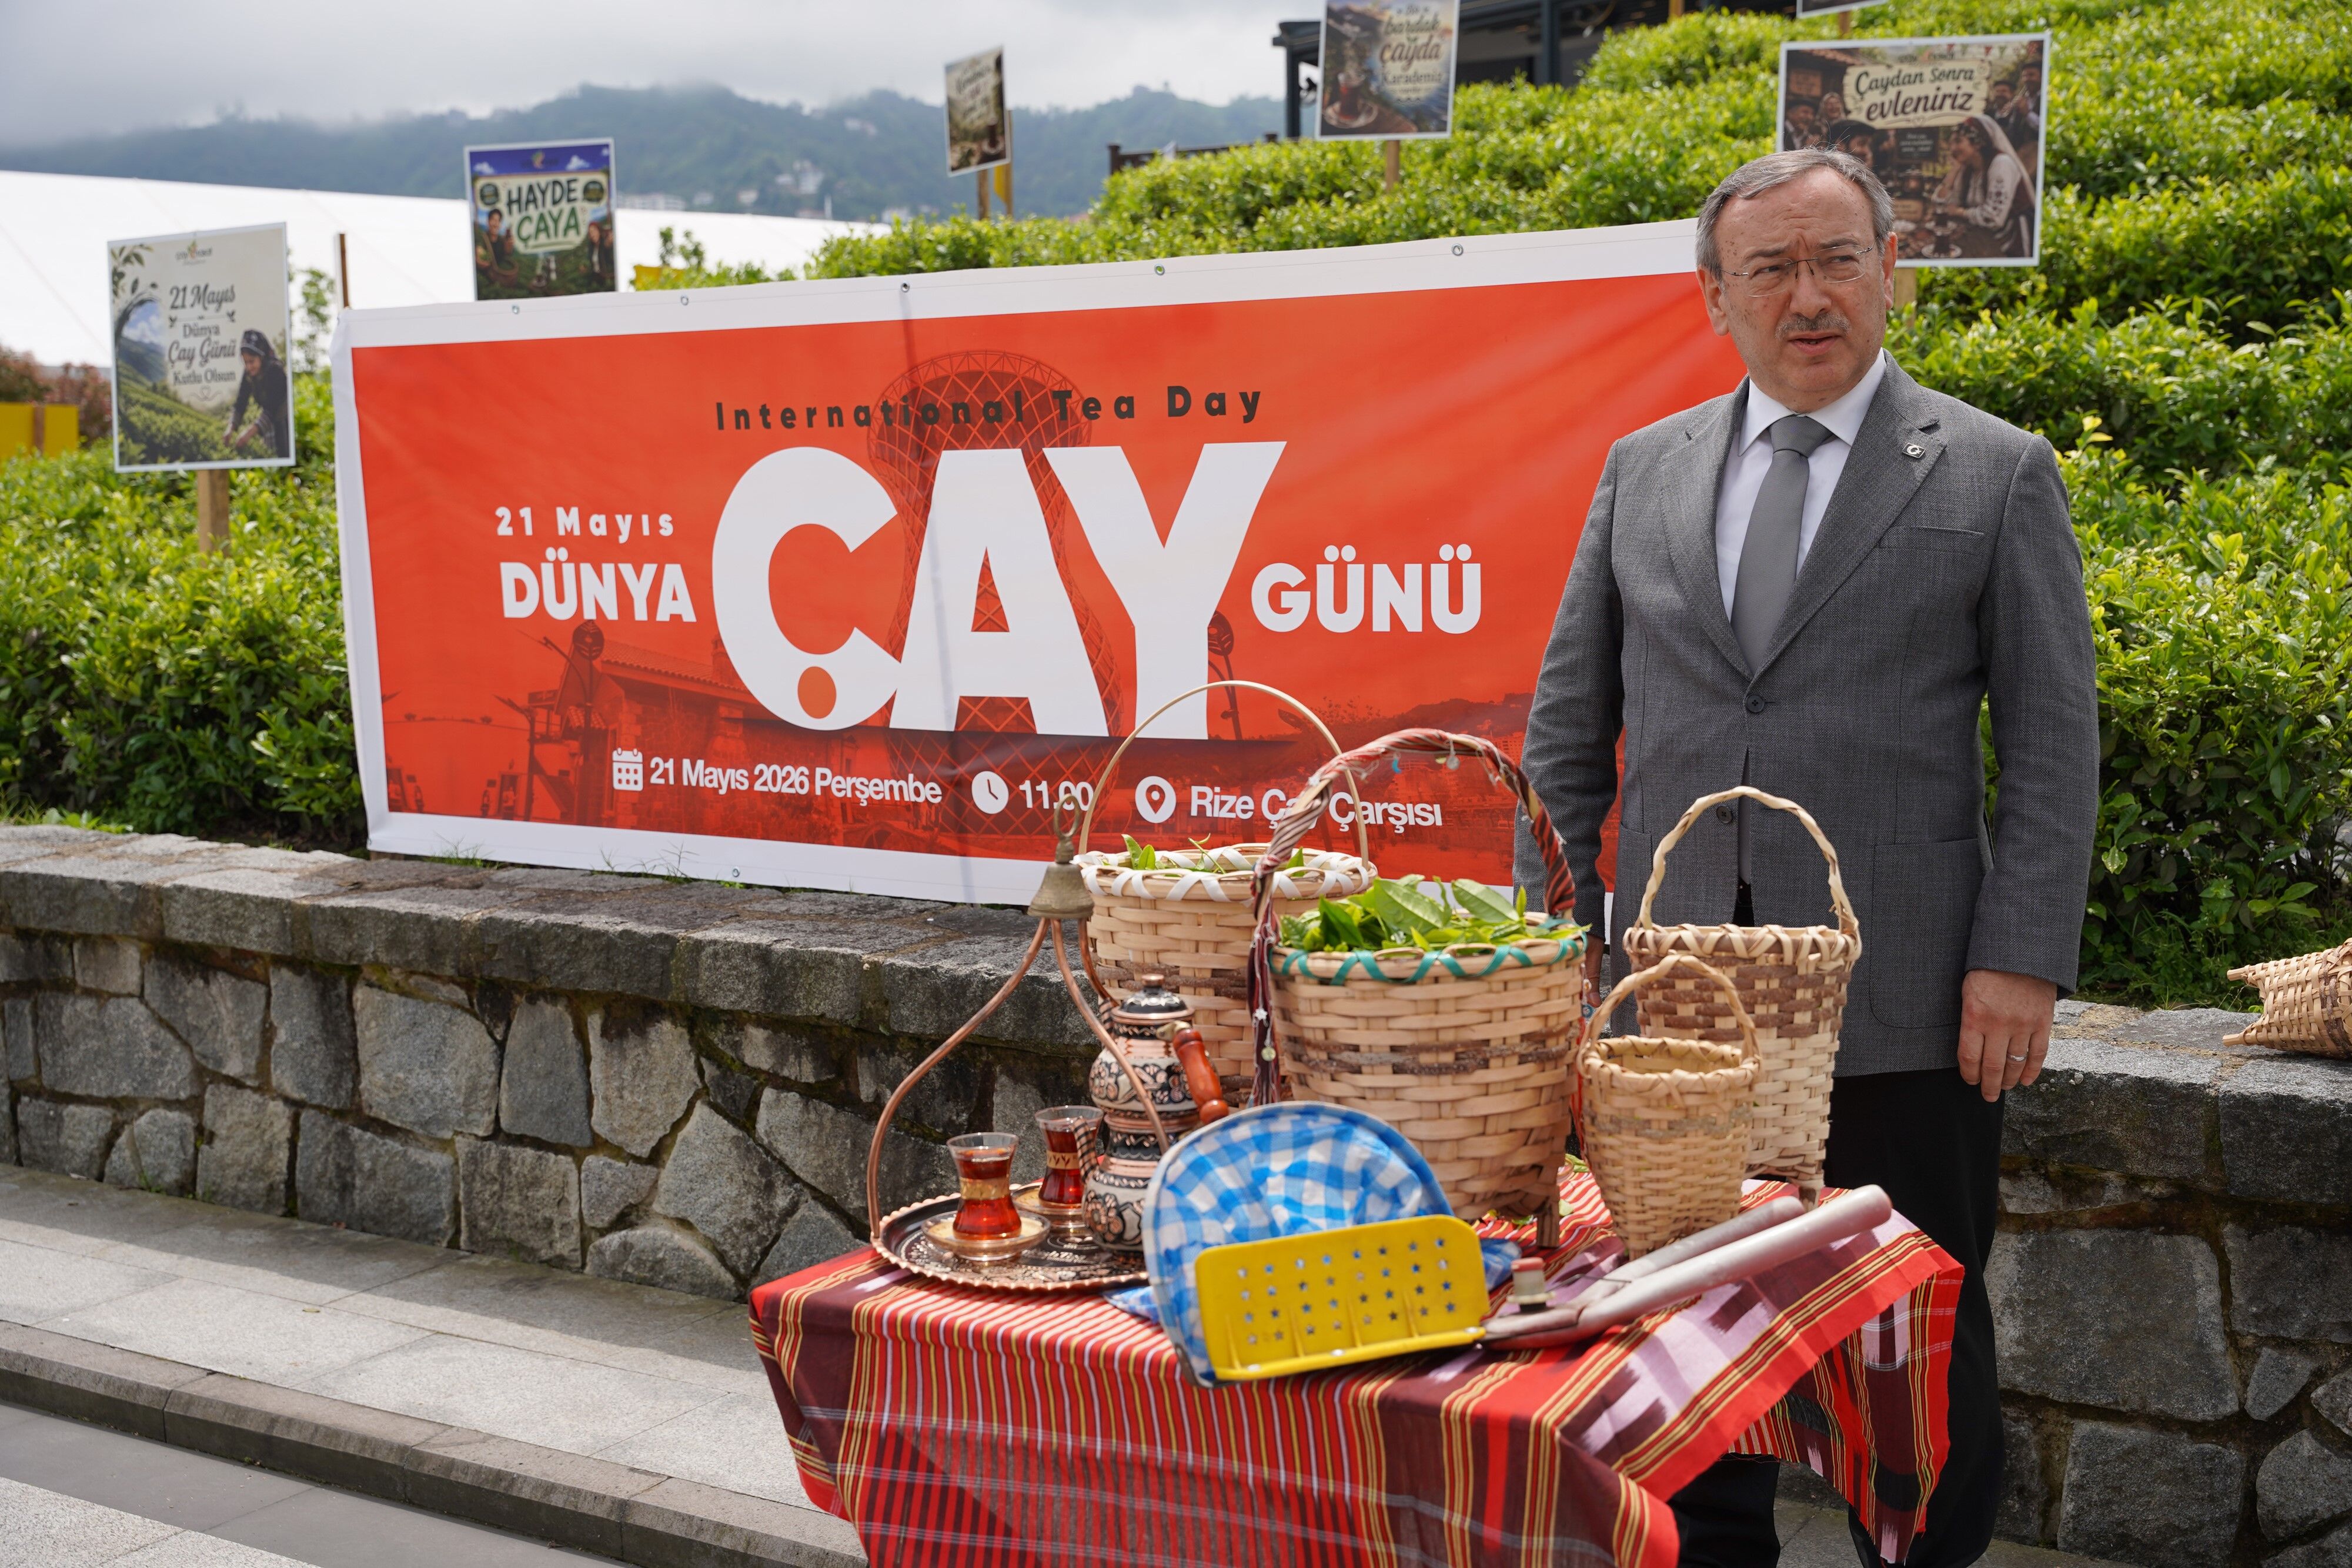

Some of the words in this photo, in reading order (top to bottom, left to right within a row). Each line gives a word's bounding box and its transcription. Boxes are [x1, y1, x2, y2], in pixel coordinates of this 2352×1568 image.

[1856, 68, 1923, 101] Çaydan
[1930, 66, 1974, 82] Sonra
[1866, 85, 1973, 121] evleniriz
[506, 178, 579, 215] HAYDE
[517, 206, 580, 248] ÇAYA
[170, 285, 187, 310] 21
[190, 283, 236, 312] Mayıs
[183, 323, 220, 342] Dünya
[168, 340, 195, 369] Çay
[199, 338, 236, 367] Günü
[173, 370, 202, 385] Kutlu
[204, 368, 236, 384] Olsun
[716, 391, 1023, 430] International
[1053, 390, 1134, 420] Tea
[1167, 386, 1261, 423] Day
[495, 506, 533, 536] 21
[556, 506, 674, 544] Mayıs
[500, 547, 697, 622] DÜNYA
[712, 442, 1287, 740] ÇAY
[1251, 544, 1481, 634] GÜNÜ
[650, 757, 674, 785] 21
[682, 758, 749, 795] Mayıs
[754, 763, 810, 795] 2026
[815, 767, 942, 807] Perşembe
[1191, 785, 1255, 820] Rize
[1329, 791, 1443, 834] Çarşısı
